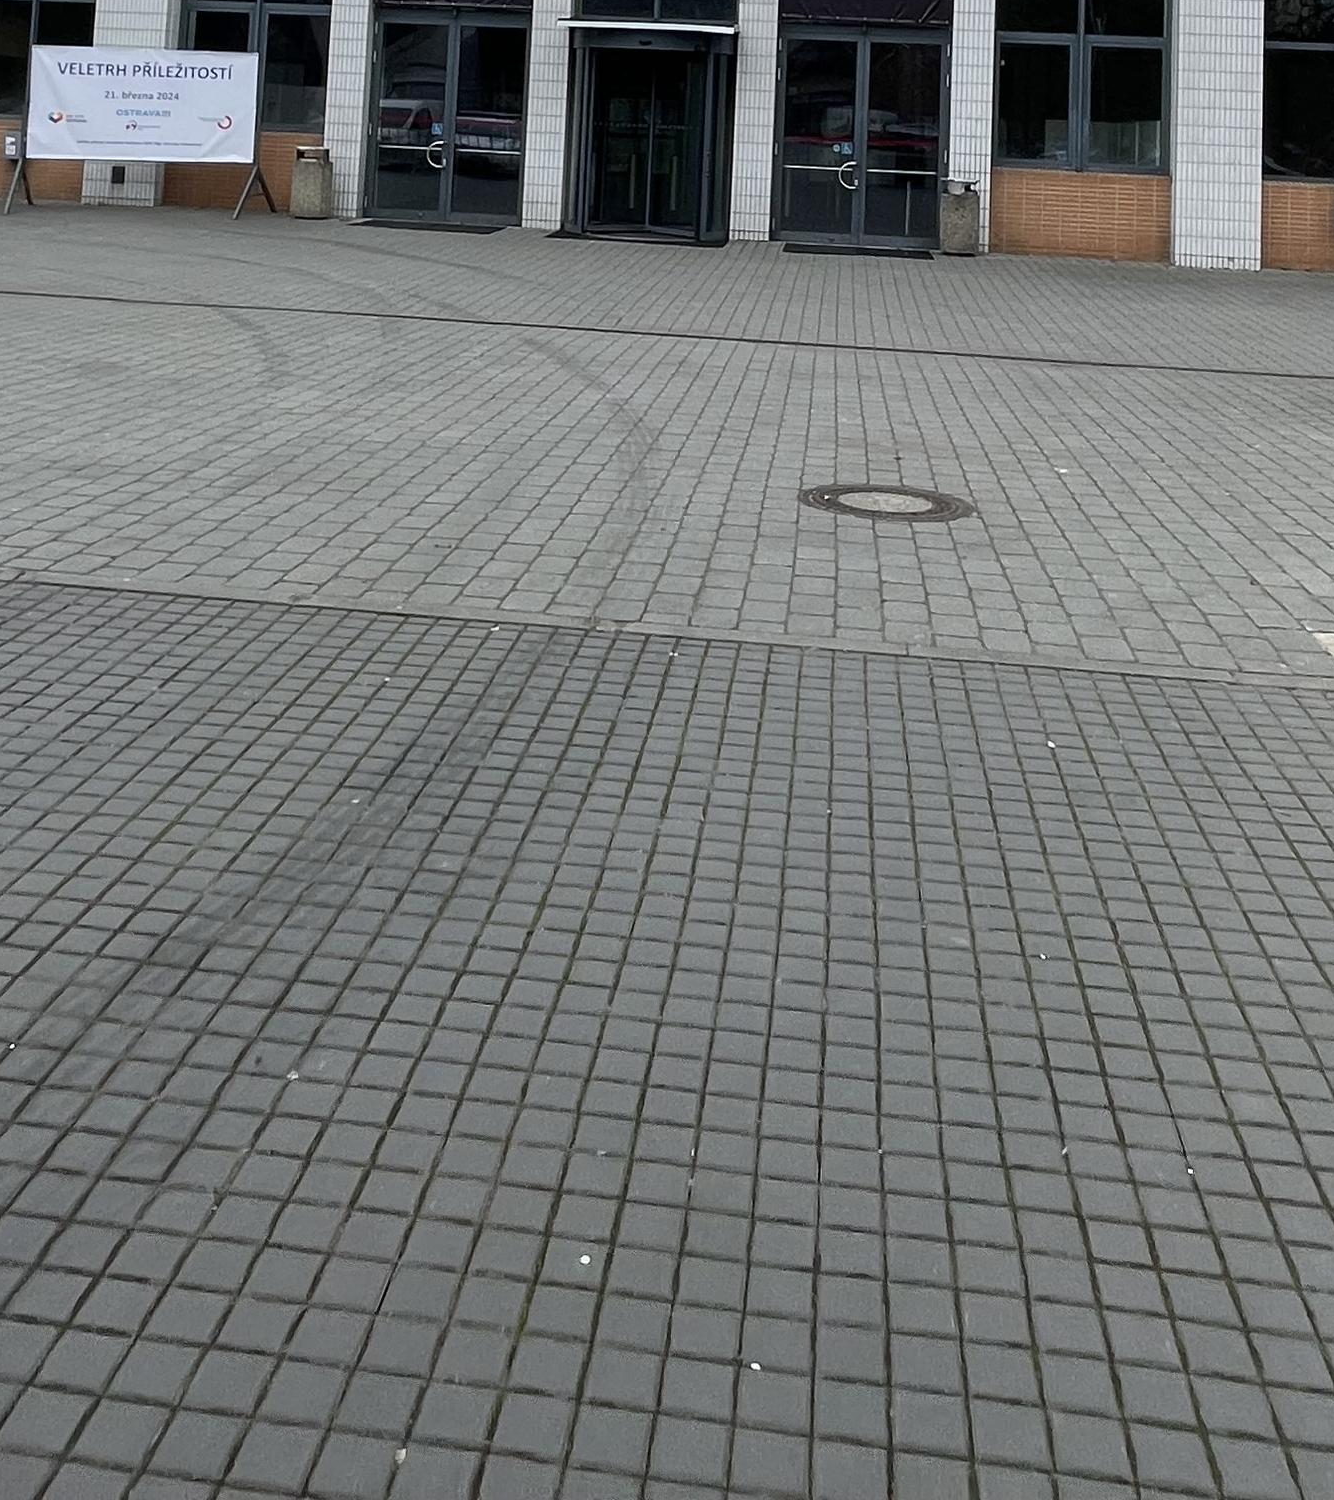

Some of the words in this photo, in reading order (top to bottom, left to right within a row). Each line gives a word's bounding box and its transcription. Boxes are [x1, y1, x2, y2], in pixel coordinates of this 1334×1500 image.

[57, 62, 127, 77] VELETRH
[132, 61, 234, 80] PŘÍLEŽITOSTÍ
[104, 90, 118, 99] 21.
[122, 91, 154, 100] března
[156, 92, 180, 100] 2024
